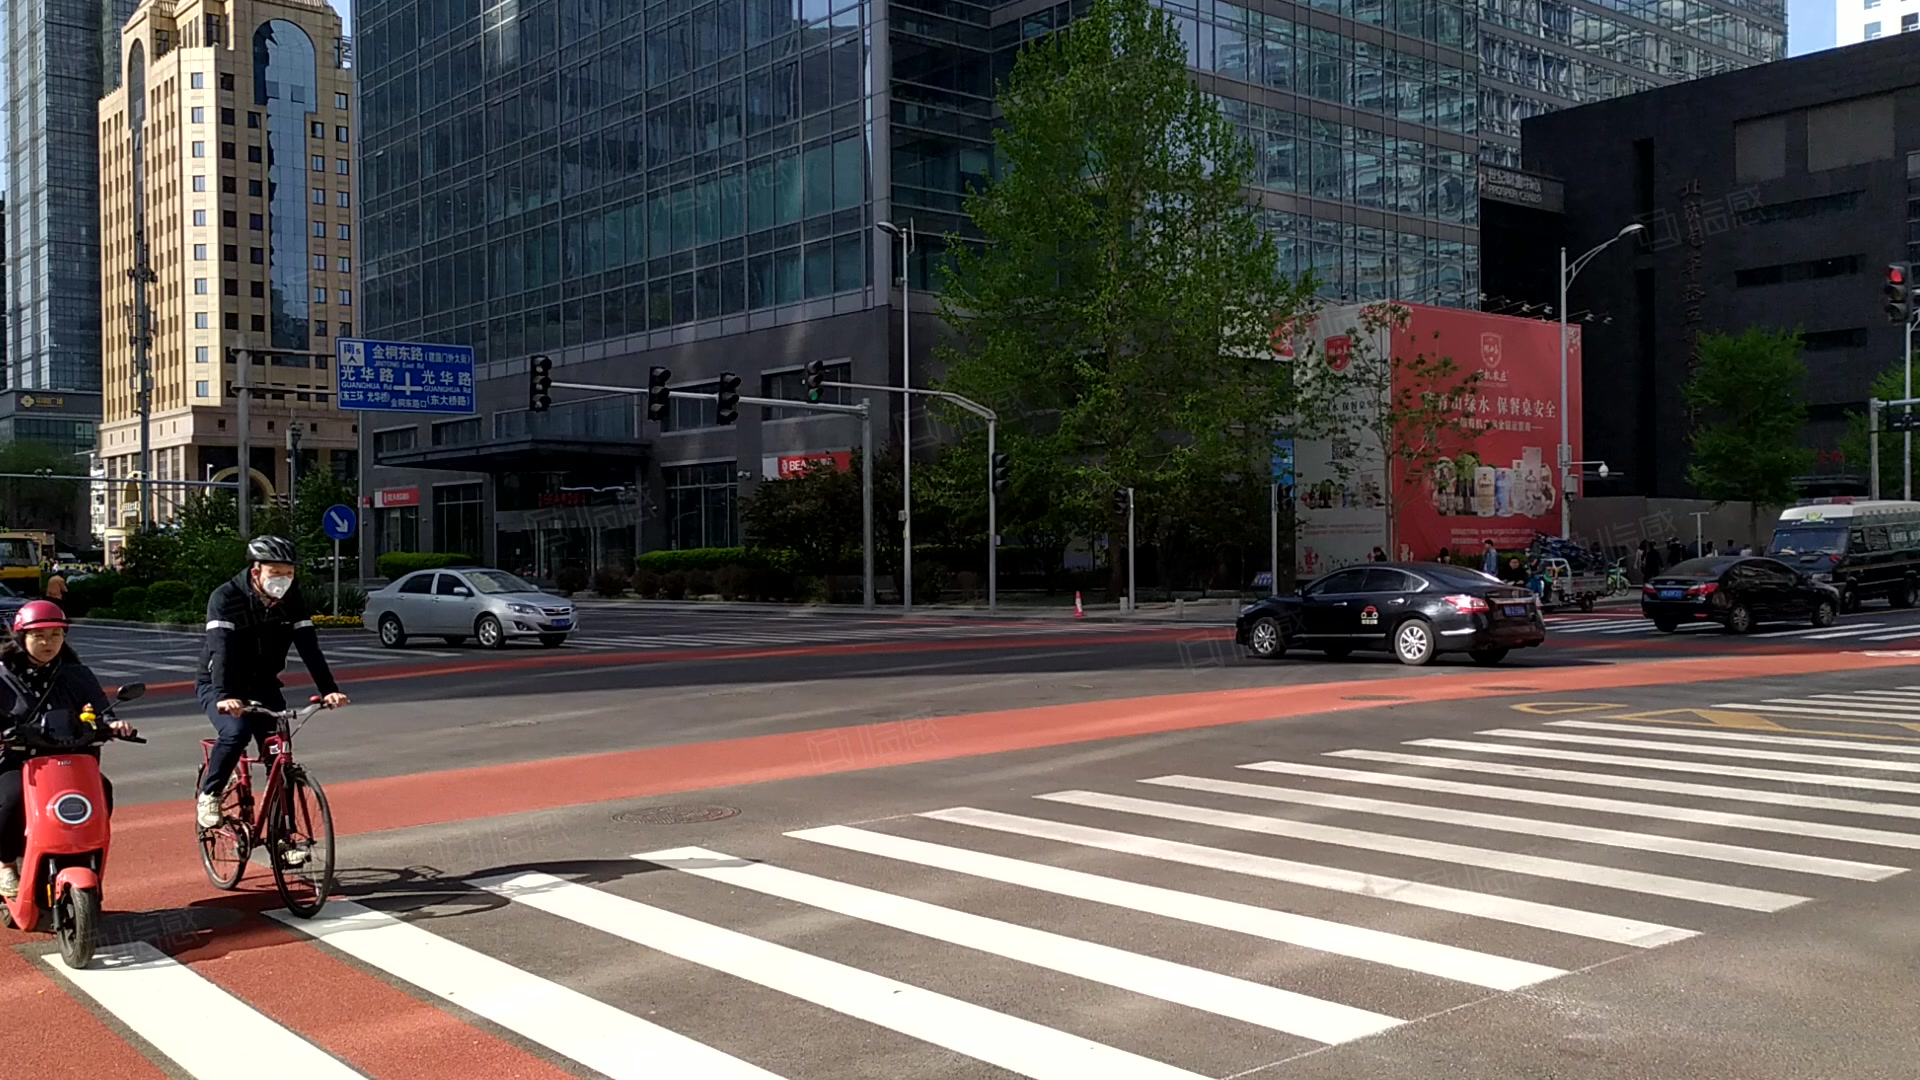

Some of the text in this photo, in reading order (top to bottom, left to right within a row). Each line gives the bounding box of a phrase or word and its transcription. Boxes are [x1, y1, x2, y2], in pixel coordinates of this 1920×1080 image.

[372, 344, 423, 361] 金桐东路
[341, 366, 394, 383] 光华路
[421, 369, 471, 387] 光华路
[341, 381, 392, 391] GUANGHUA Rd
[423, 385, 461, 394] GUANGHUA
[1497, 396, 1556, 418] 保餐桌安全
